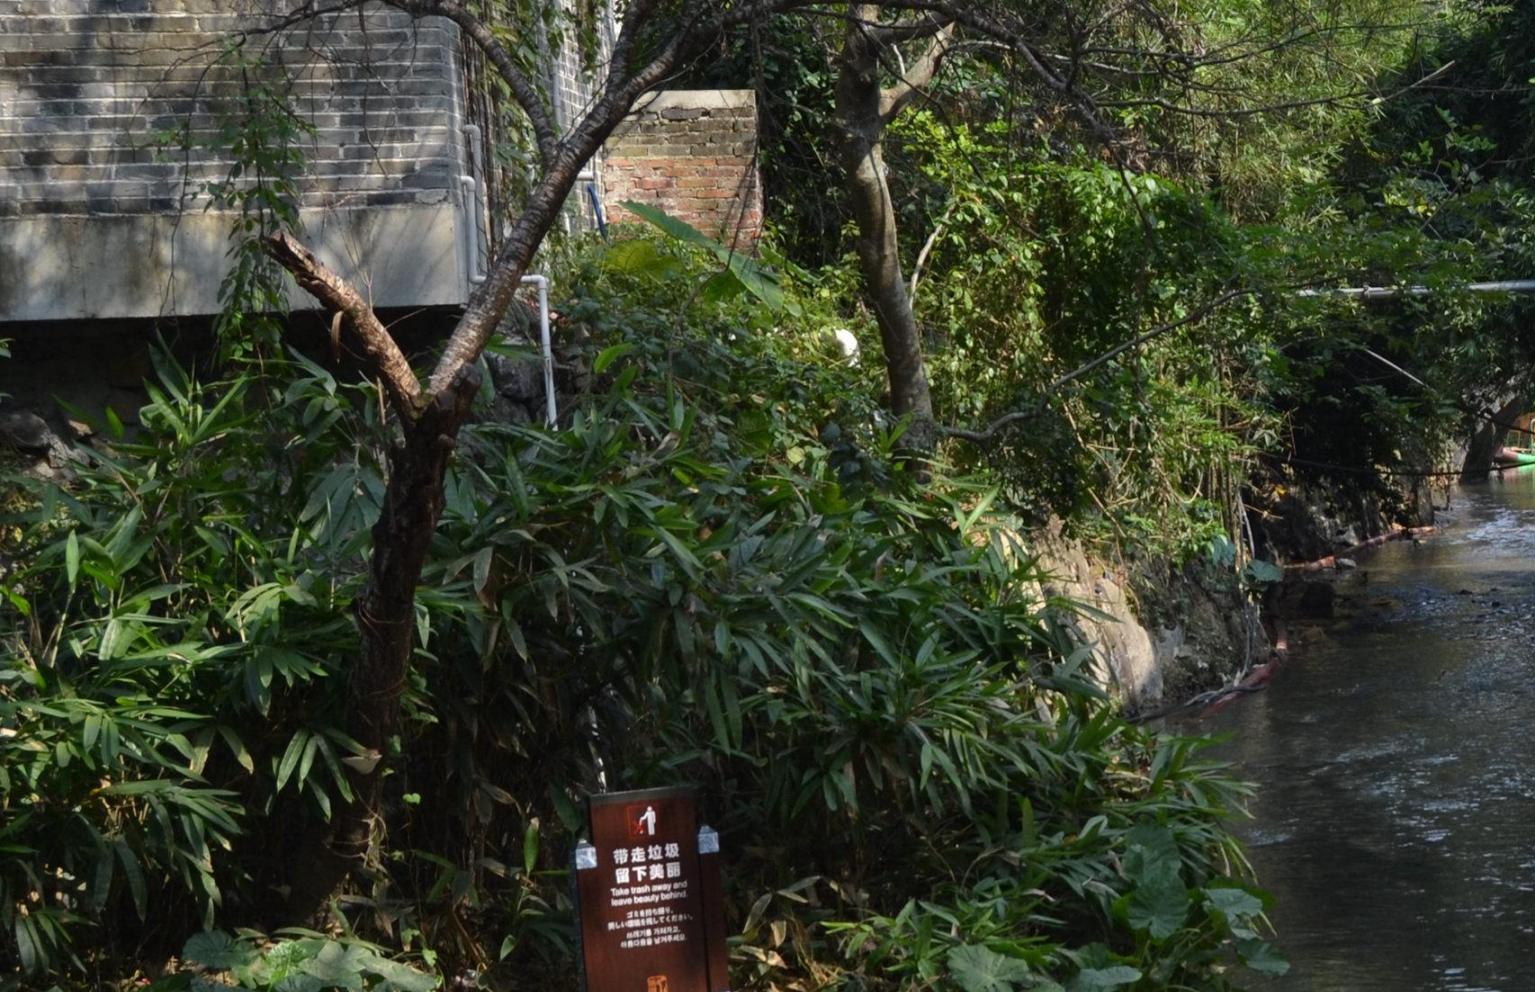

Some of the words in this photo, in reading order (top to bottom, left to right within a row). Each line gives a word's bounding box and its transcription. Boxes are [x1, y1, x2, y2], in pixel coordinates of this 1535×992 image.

[613, 843, 679, 864] 带走垃圾
[615, 862, 681, 883] 留下美丽
[611, 887, 629, 897] Take
[631, 885, 651, 894] trash
[652, 883, 671, 892] away
[673, 881, 687, 890] and
[611, 897, 632, 906] leave
[634, 894, 659, 903] beauty
